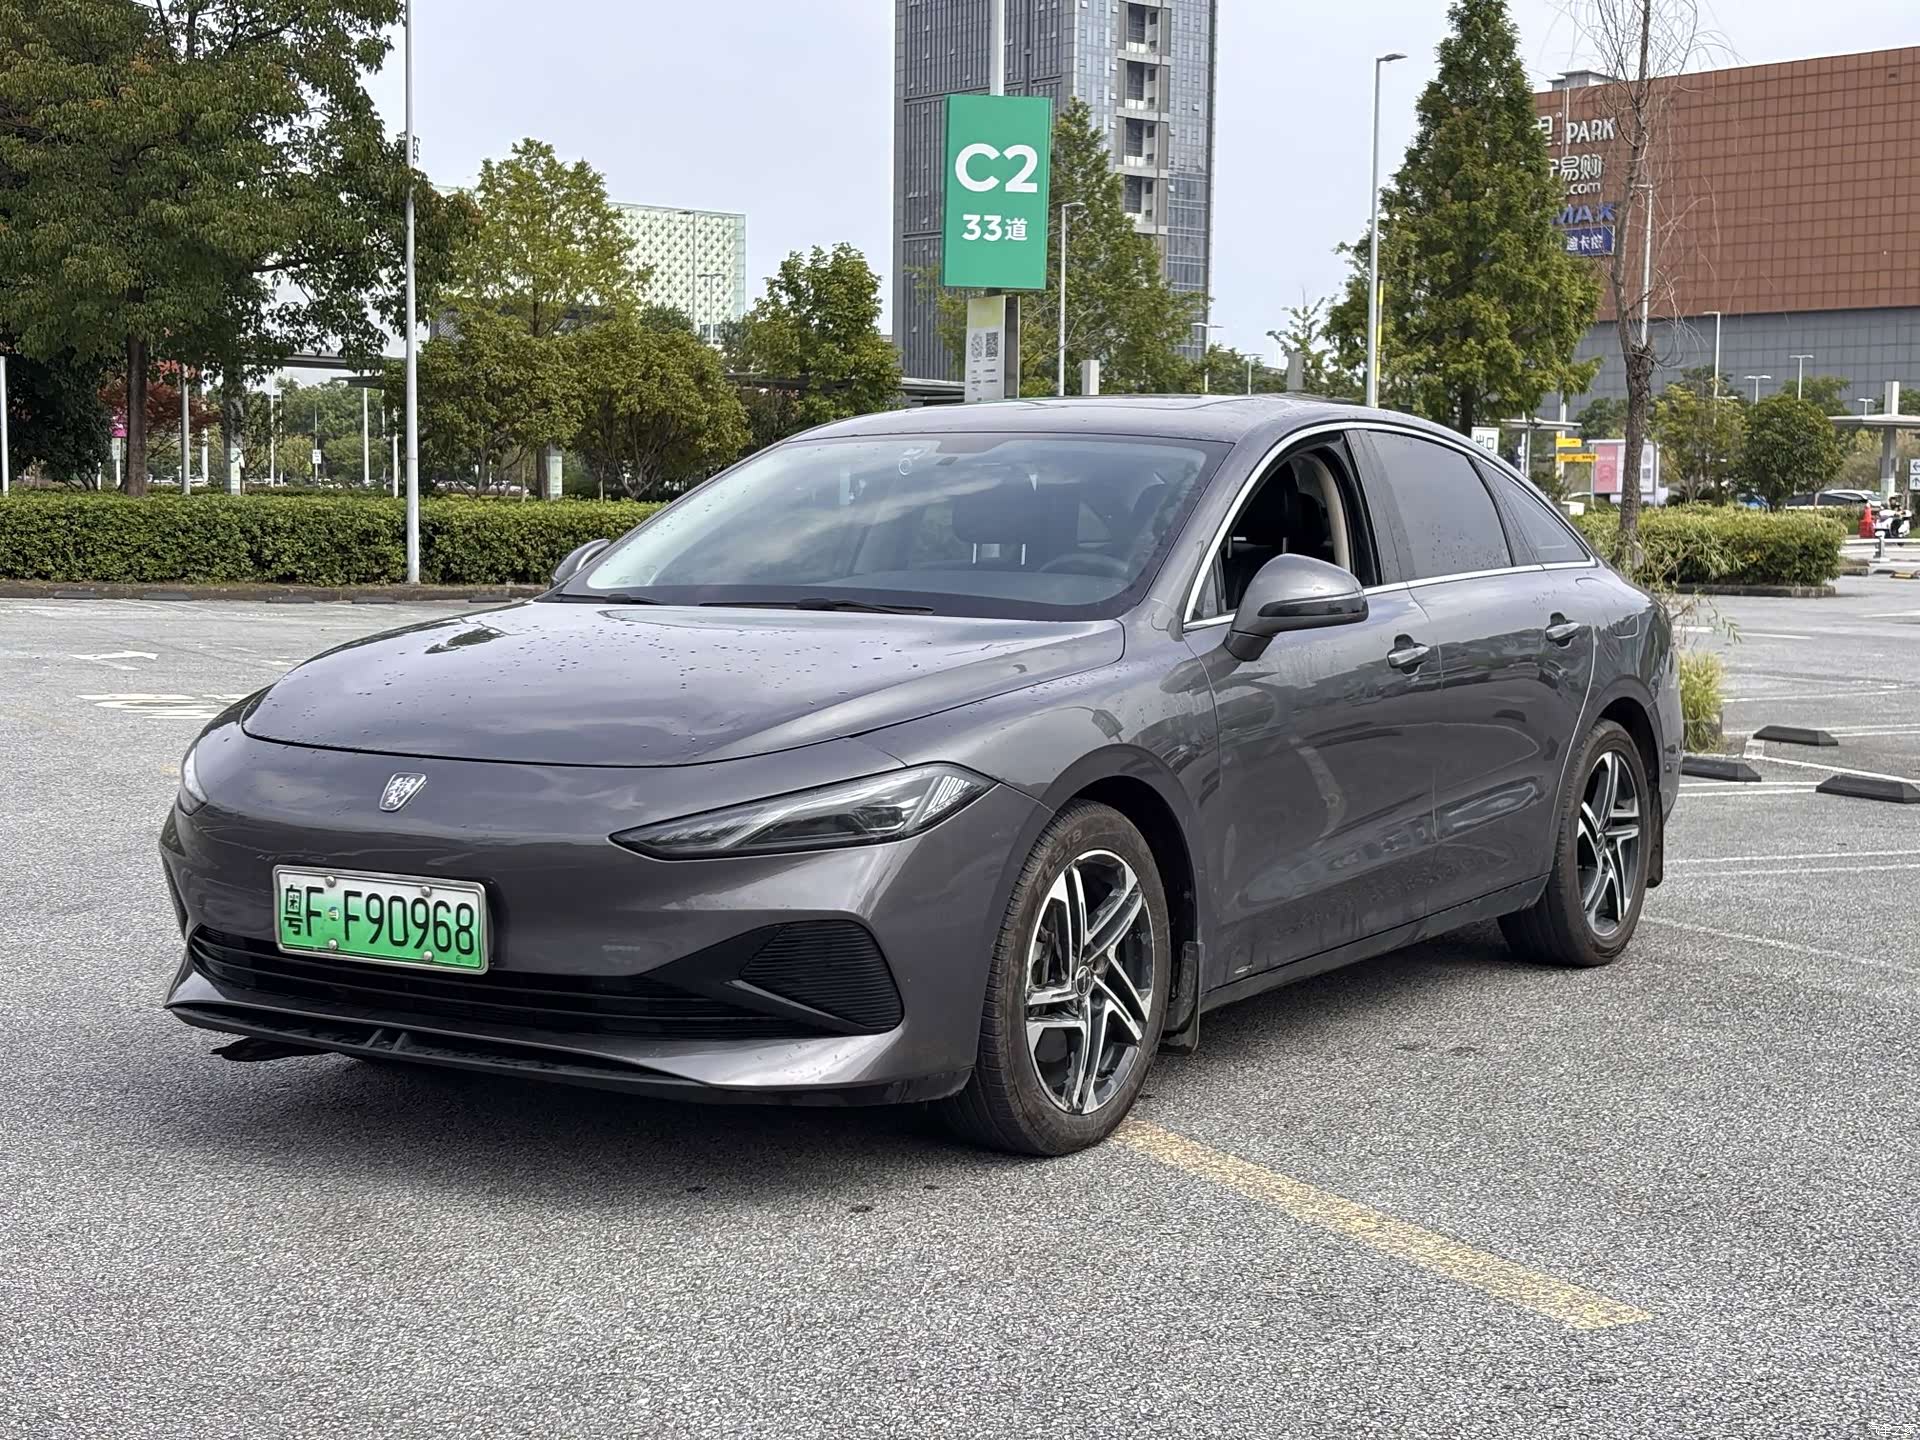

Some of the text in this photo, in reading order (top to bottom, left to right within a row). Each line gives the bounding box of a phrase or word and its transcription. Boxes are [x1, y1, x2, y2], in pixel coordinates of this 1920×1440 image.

[1566, 117, 1616, 144] PARK
[955, 143, 1038, 193] C2
[962, 214, 1028, 241] 33道
[343, 889, 475, 955] F90968
